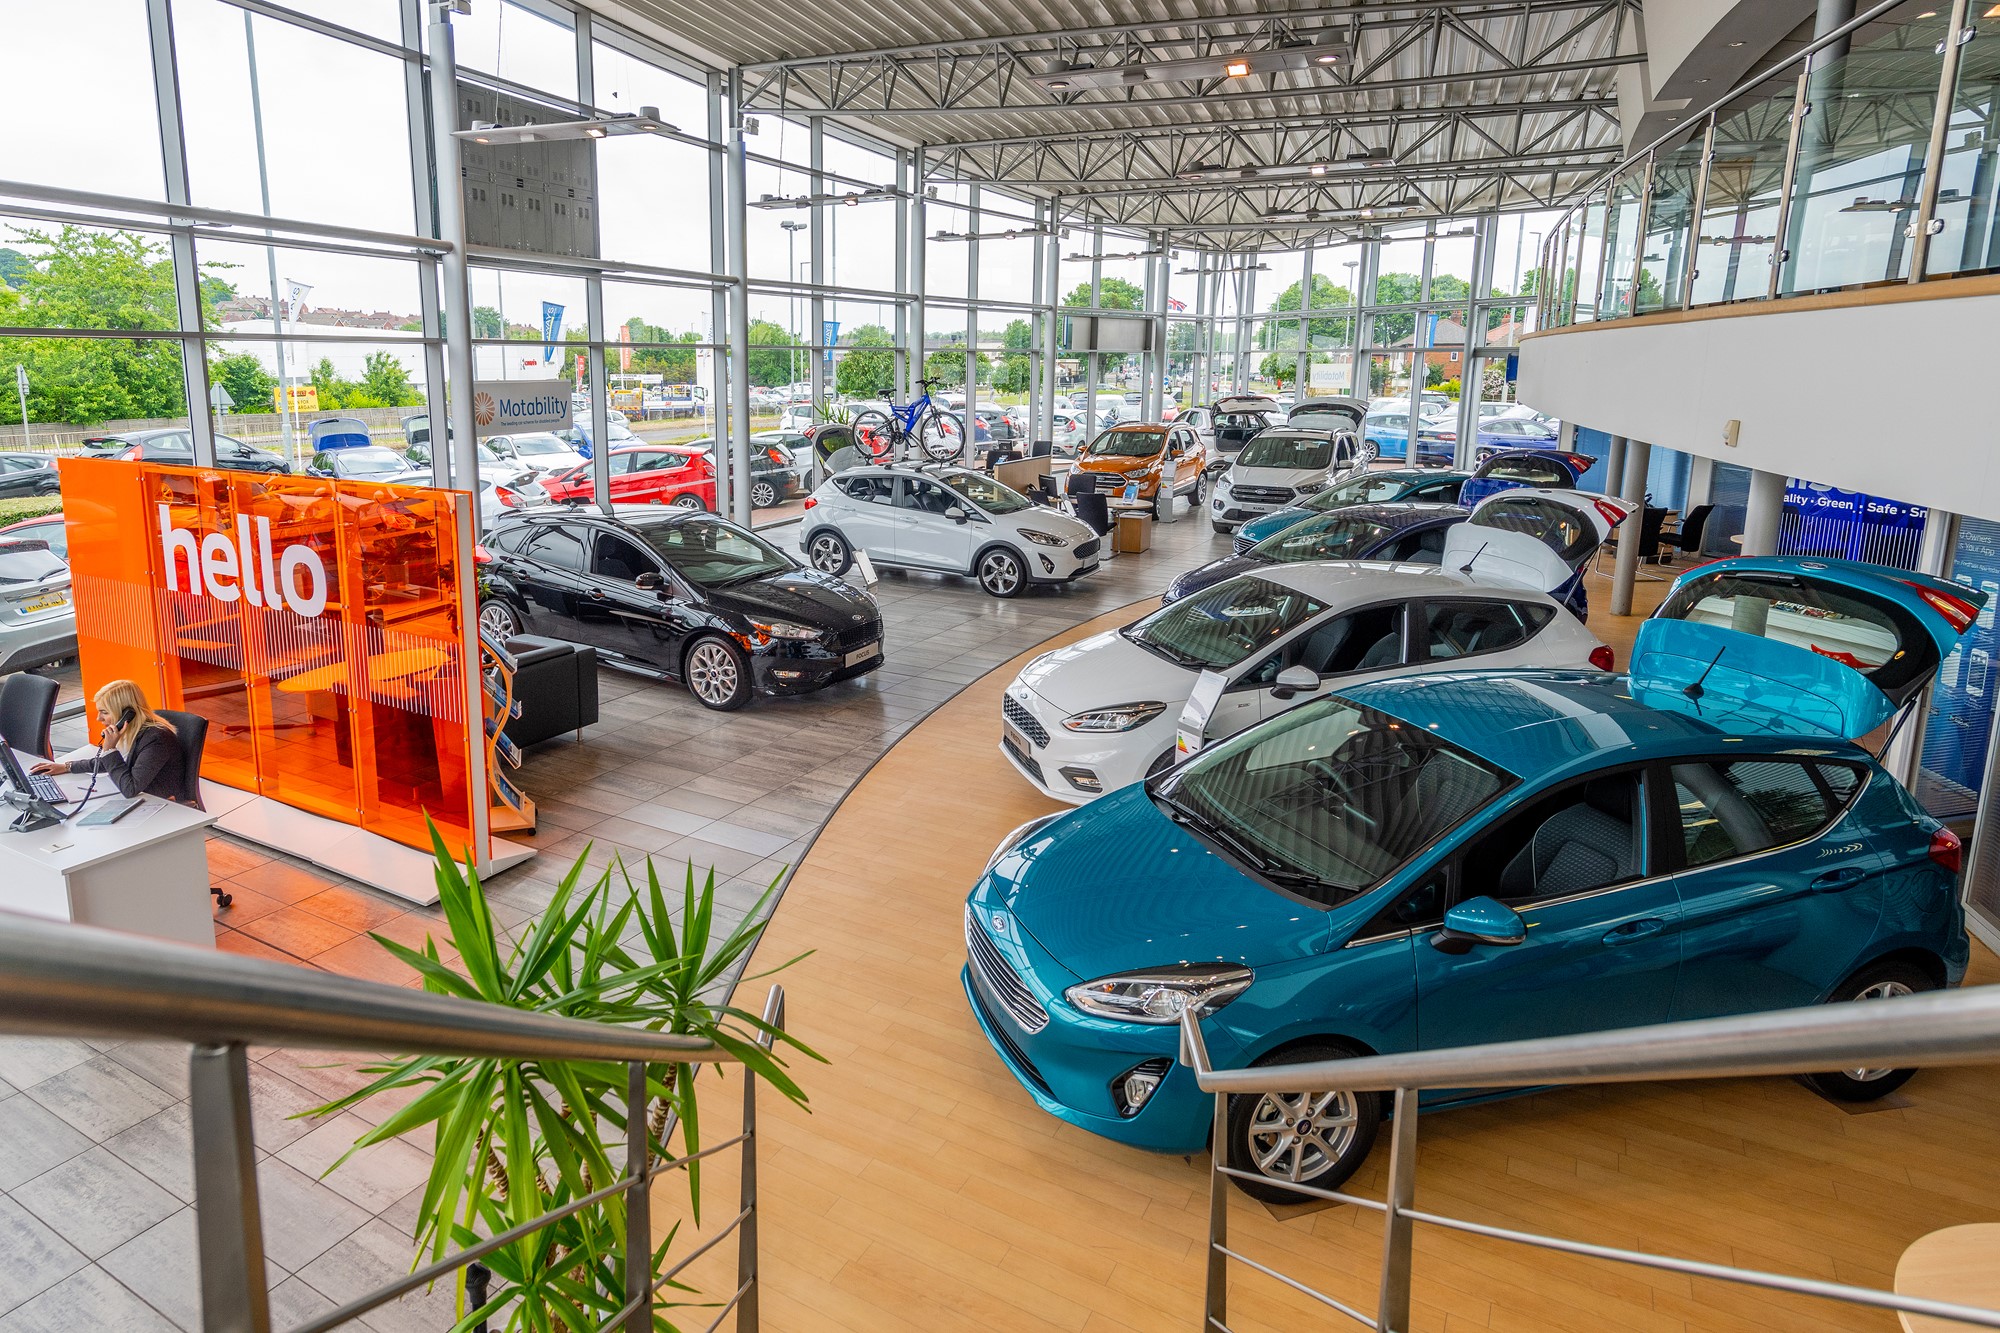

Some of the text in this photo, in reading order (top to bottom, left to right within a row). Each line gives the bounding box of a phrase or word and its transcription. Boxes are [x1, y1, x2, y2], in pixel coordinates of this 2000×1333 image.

[500, 396, 568, 419] Motability
[1817, 497, 1853, 510] Green
[1867, 502, 1898, 515] Safe
[1966, 532, 1992, 544] Owners
[1965, 543, 1980, 552] Your
[1980, 546, 1995, 557] App
[158, 503, 328, 618] hello
[855, 650, 870, 660] FOCUS
